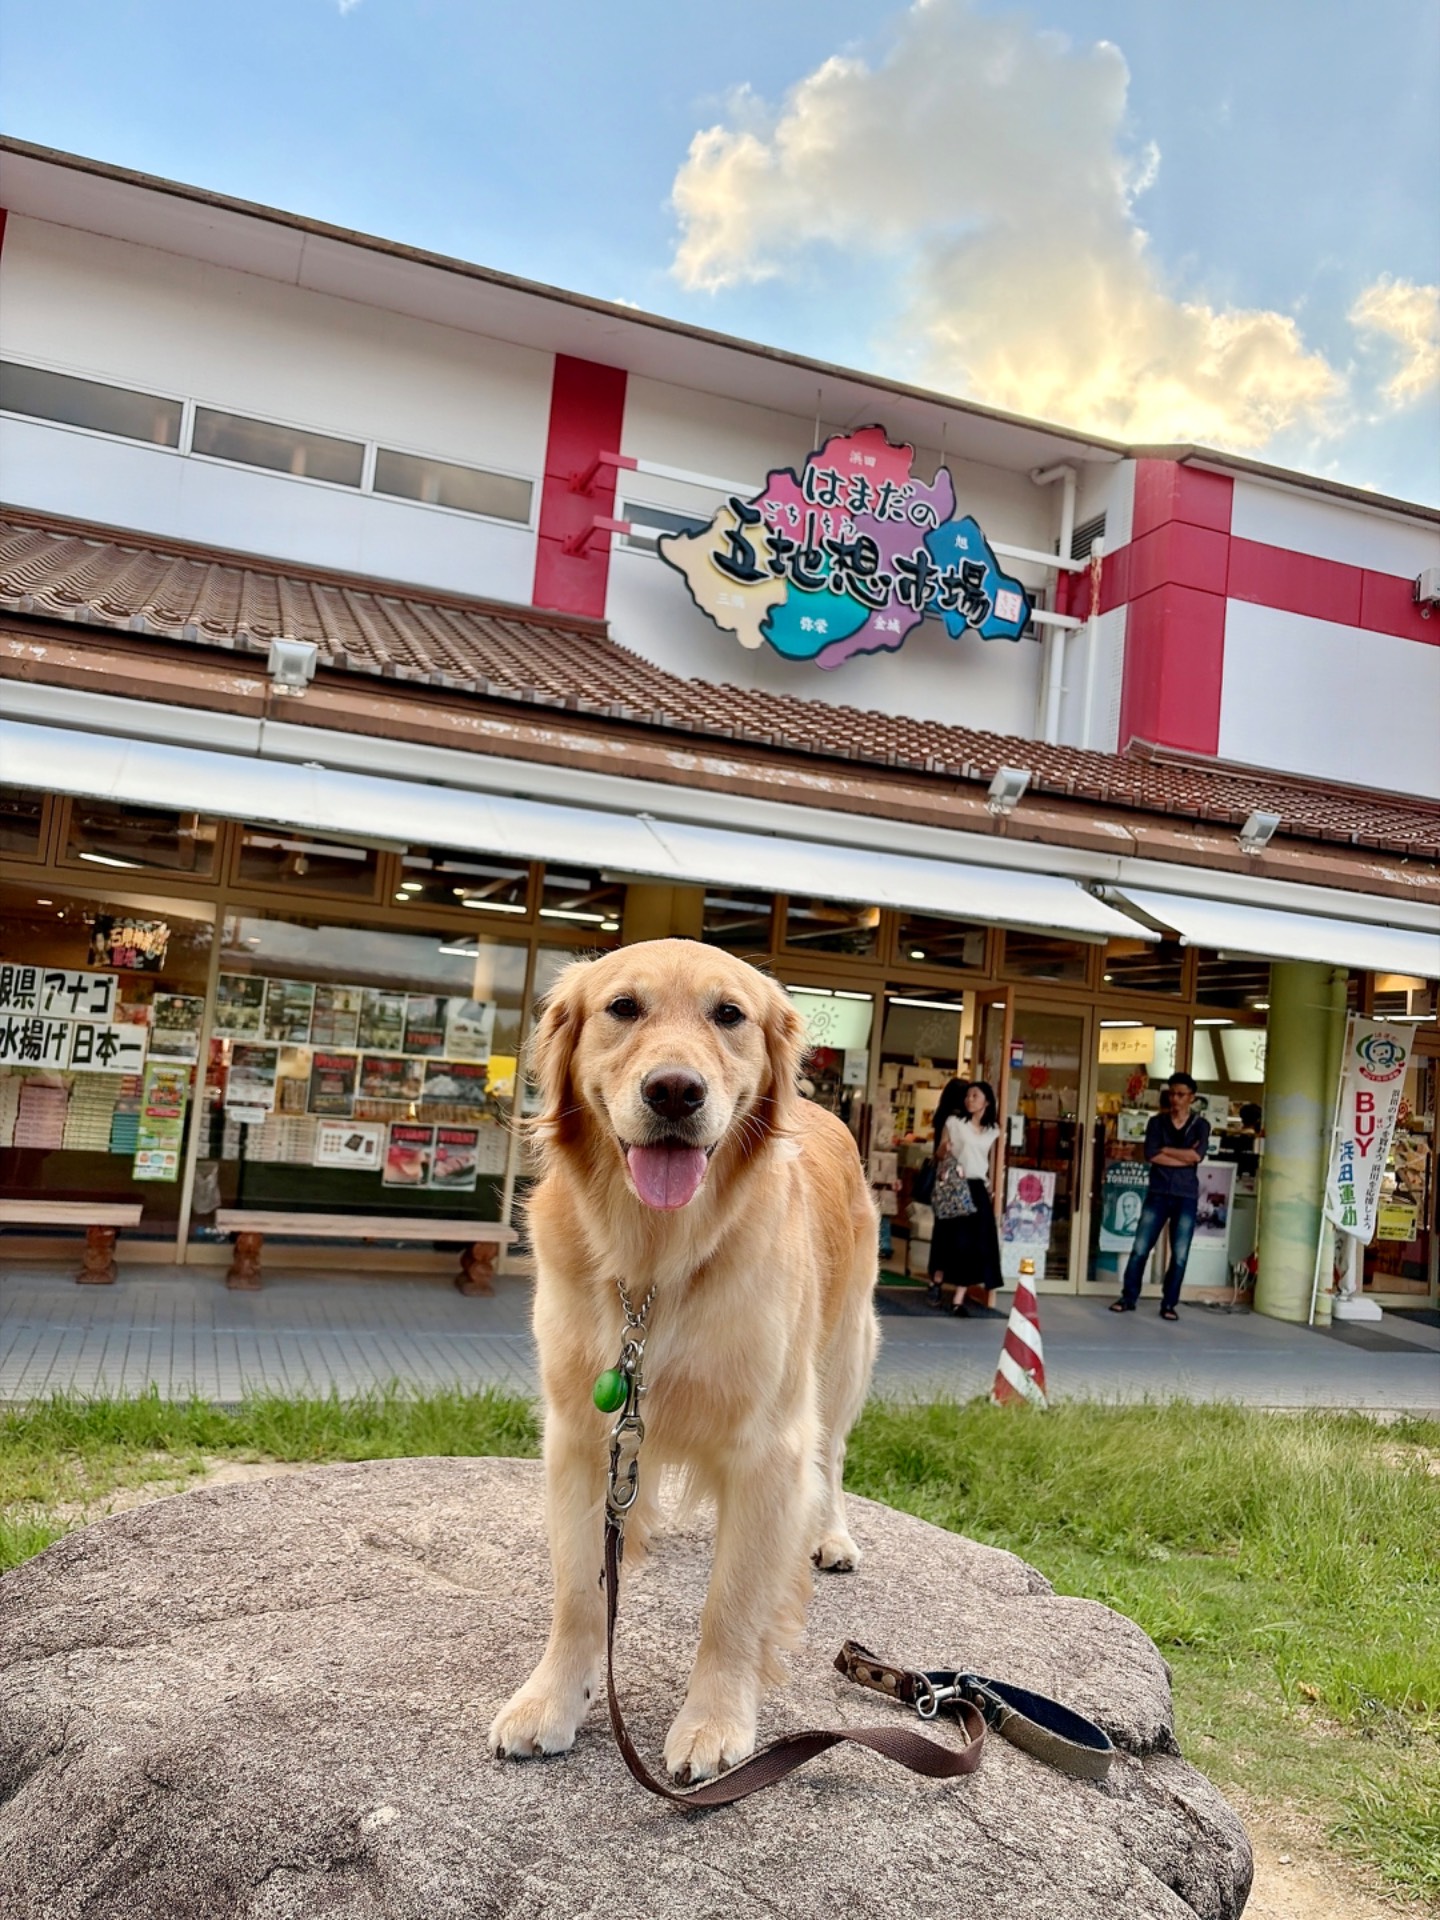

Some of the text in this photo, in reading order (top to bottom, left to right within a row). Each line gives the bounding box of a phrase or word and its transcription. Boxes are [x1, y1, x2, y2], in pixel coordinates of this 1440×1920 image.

[849, 451, 876, 467] 浜田
[765, 501, 856, 534] ごちそう
[805, 466, 939, 528] はまだの
[711, 496, 990, 627] 五地想市場
[955, 534, 968, 550] 旭
[1355, 1091, 1375, 1157] BUY
[1338, 1141, 1357, 1226] 浜田運動
